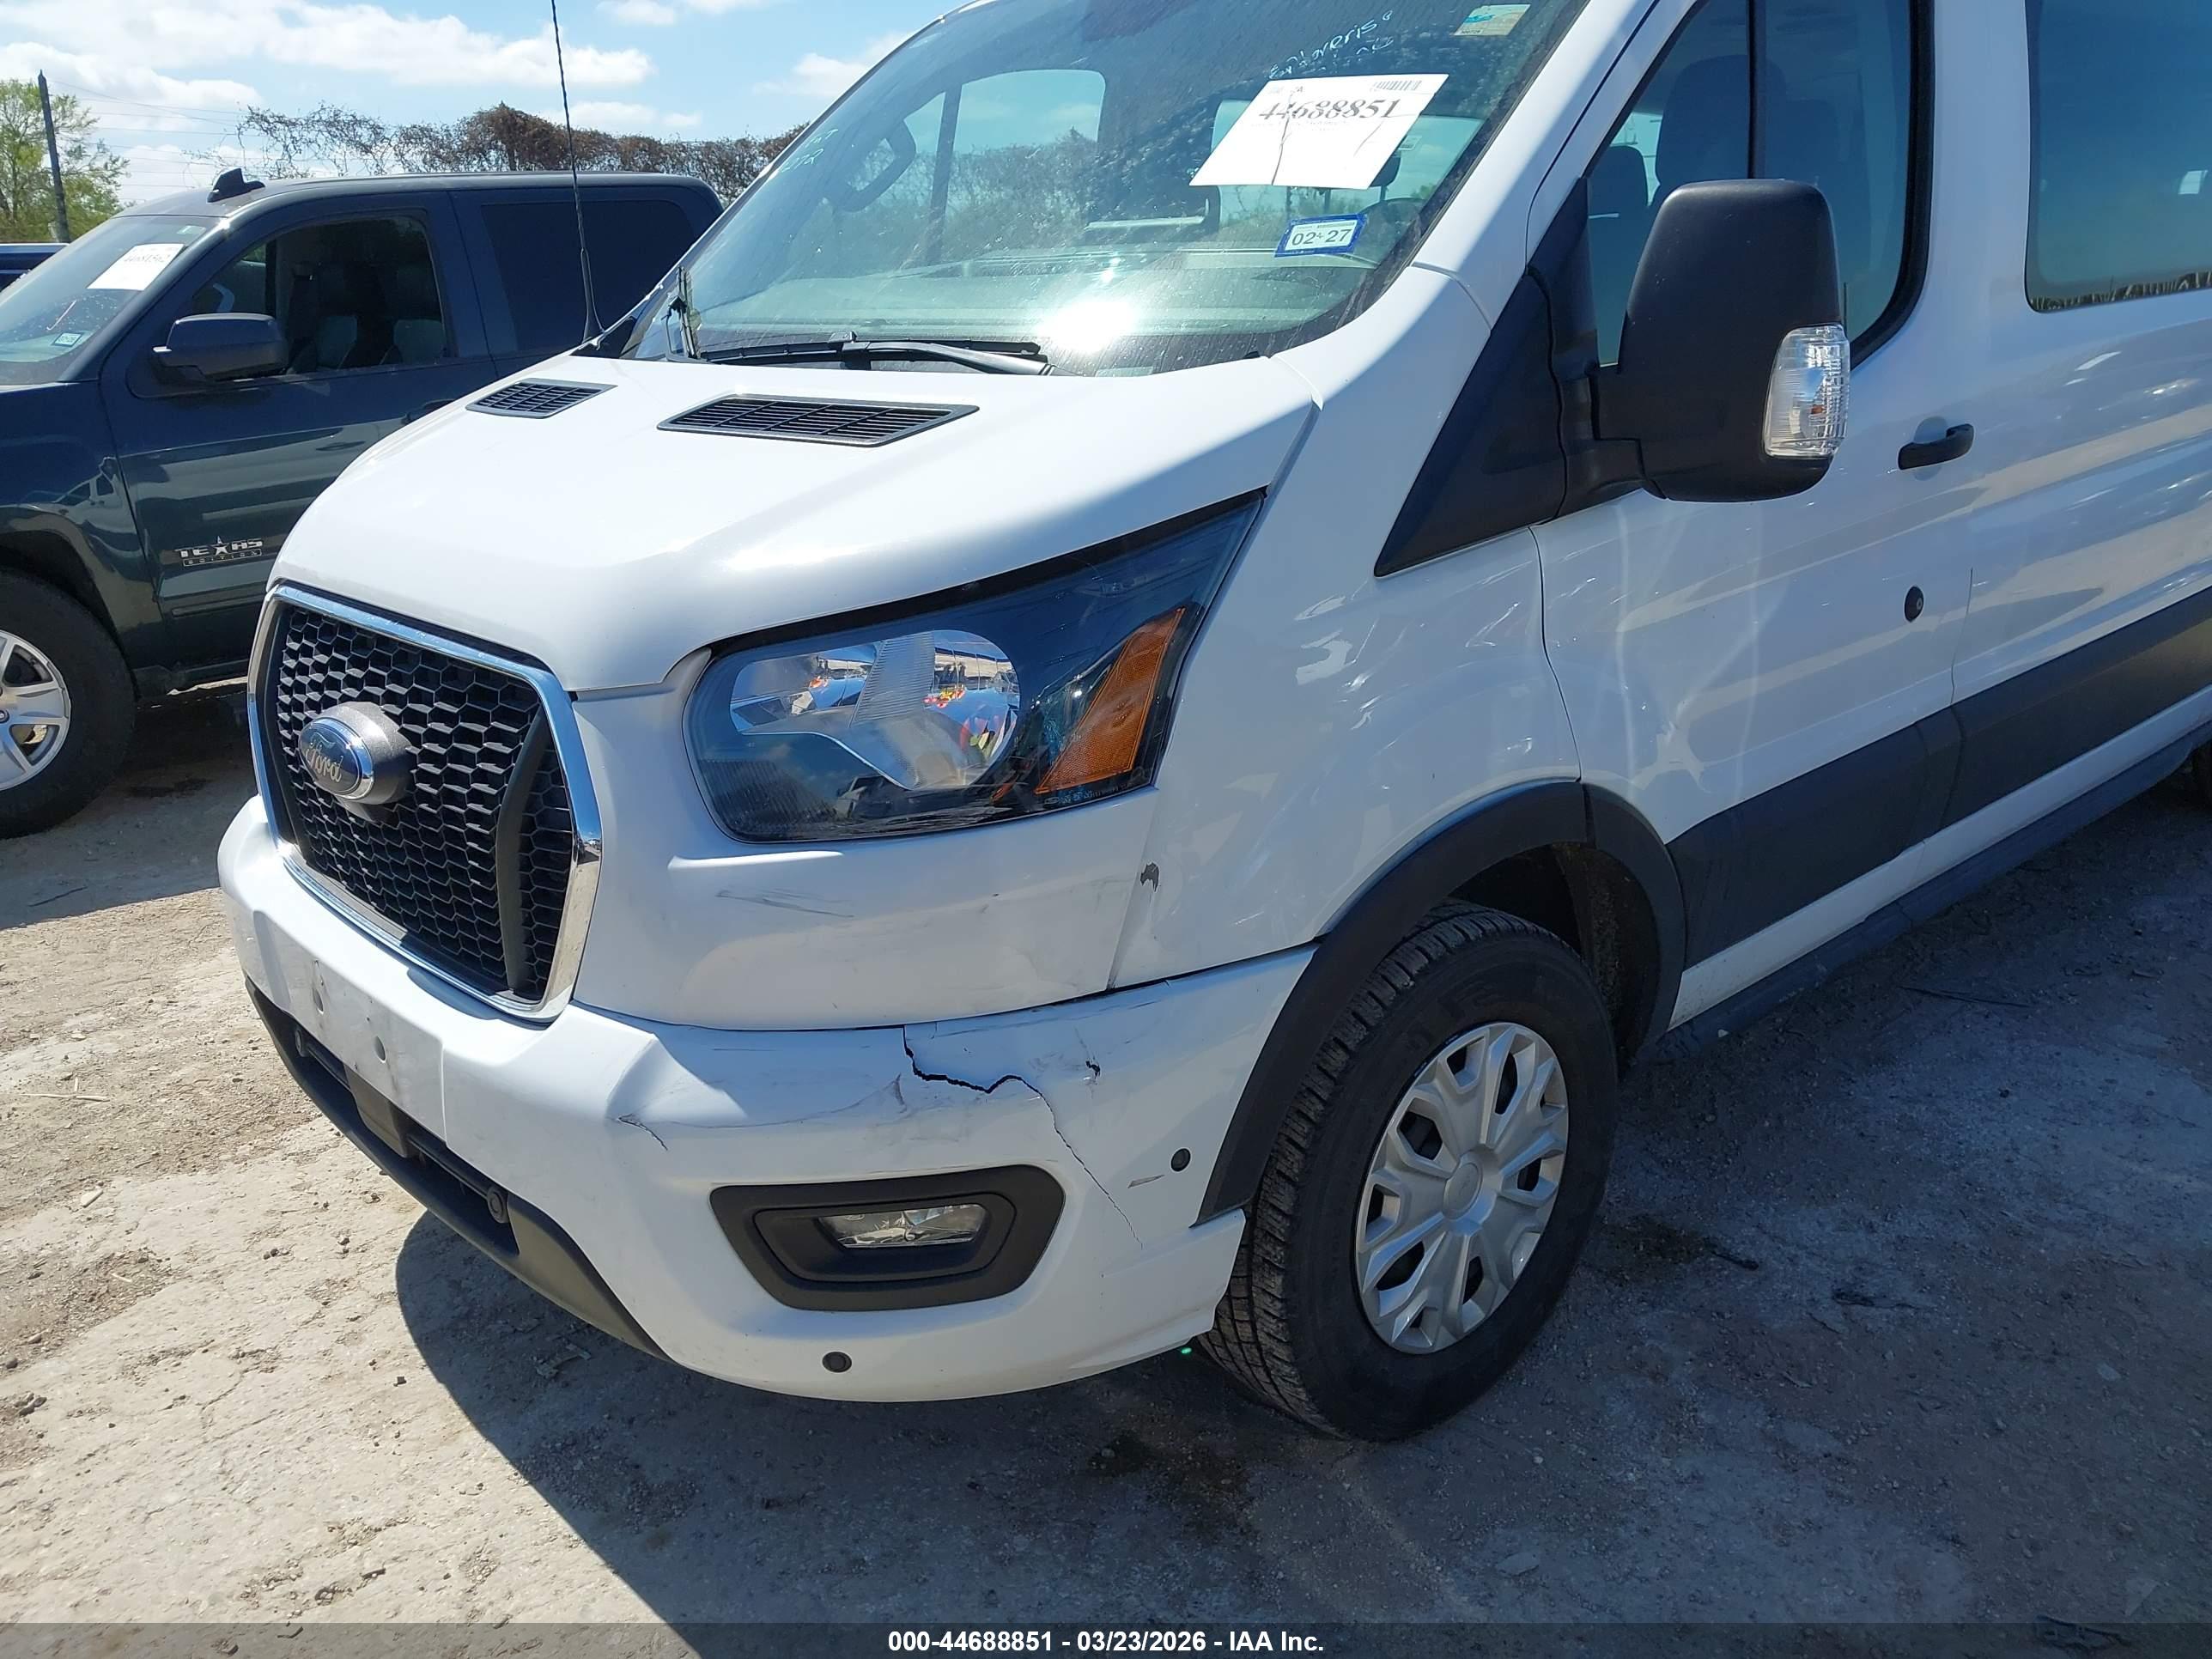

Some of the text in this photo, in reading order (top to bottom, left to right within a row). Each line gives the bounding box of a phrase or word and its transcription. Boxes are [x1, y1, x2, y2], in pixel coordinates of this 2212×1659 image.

[1258, 98, 1401, 120] 44688851
[173, 536, 264, 558] TEXAS
[304, 731, 345, 784] Ford
